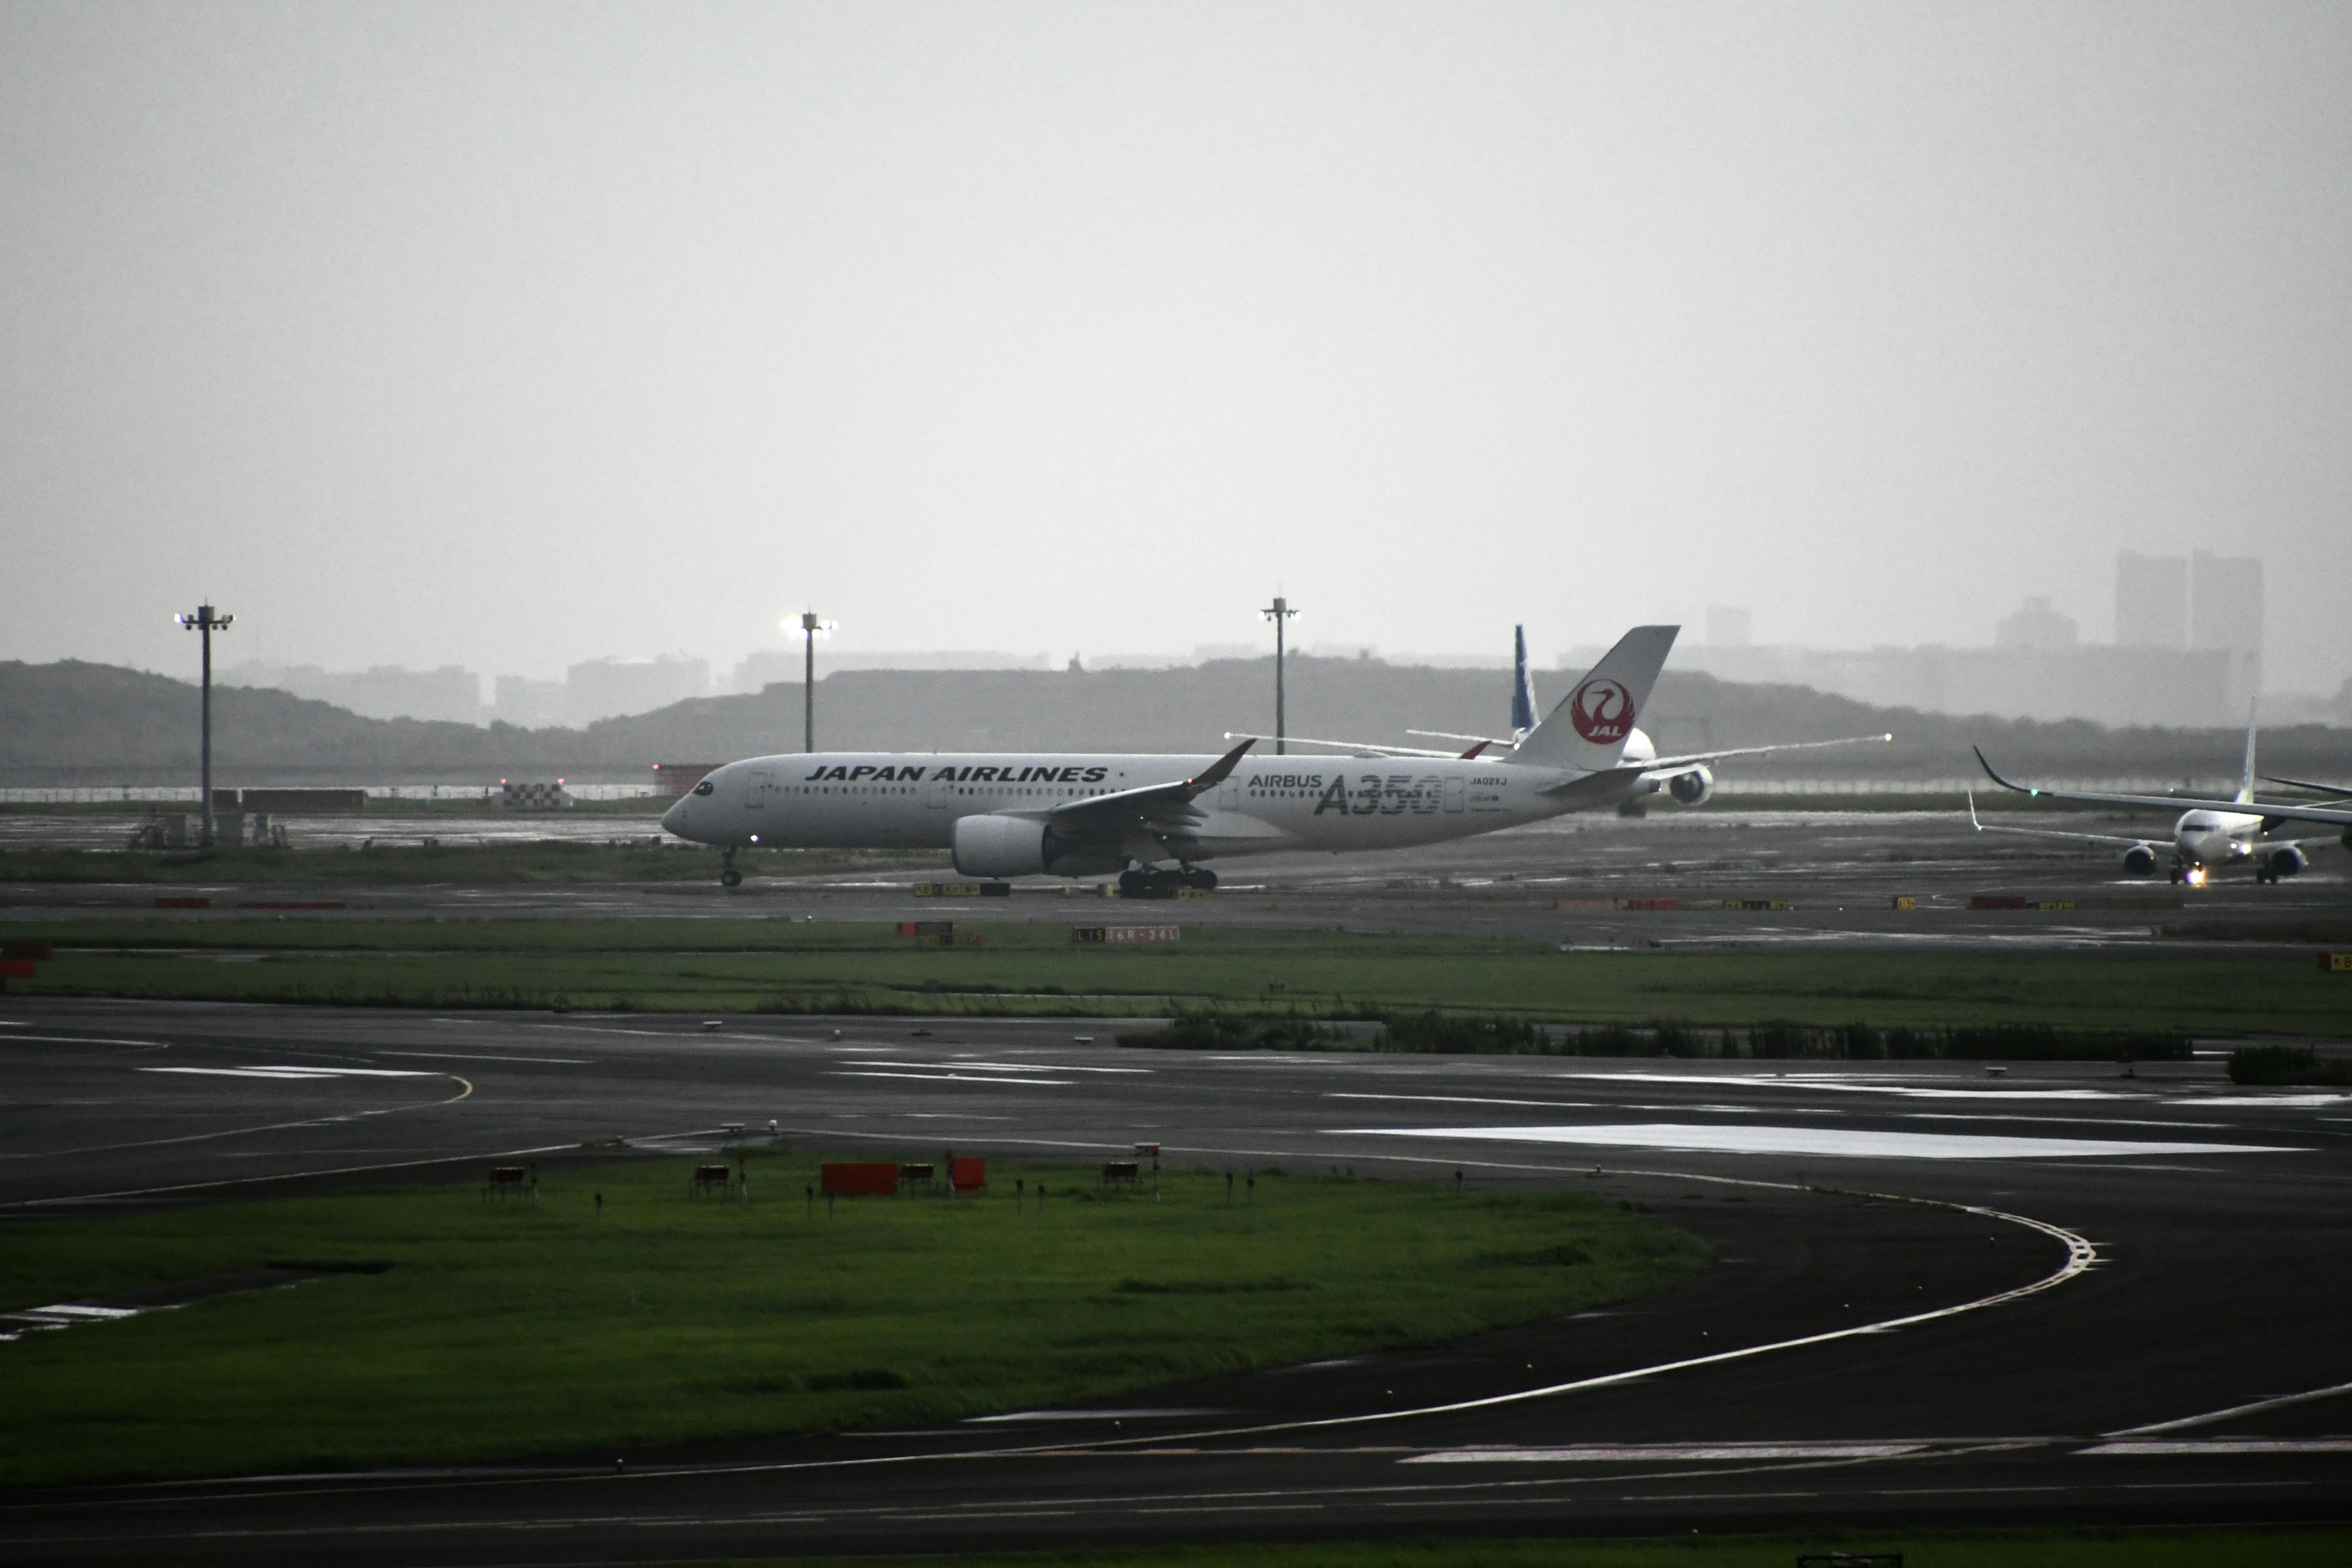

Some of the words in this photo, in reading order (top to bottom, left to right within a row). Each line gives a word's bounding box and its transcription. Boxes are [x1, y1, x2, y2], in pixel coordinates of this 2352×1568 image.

[1588, 725, 1623, 736] JAL
[805, 766, 926, 781] JAPAN
[932, 766, 1109, 782] AIRLINES
[1248, 774, 1322, 788] AIRBUS
[1314, 774, 1443, 815] A350
[1109, 929, 1175, 940] 16R-34L
[2345, 957, 2351, 967] B
